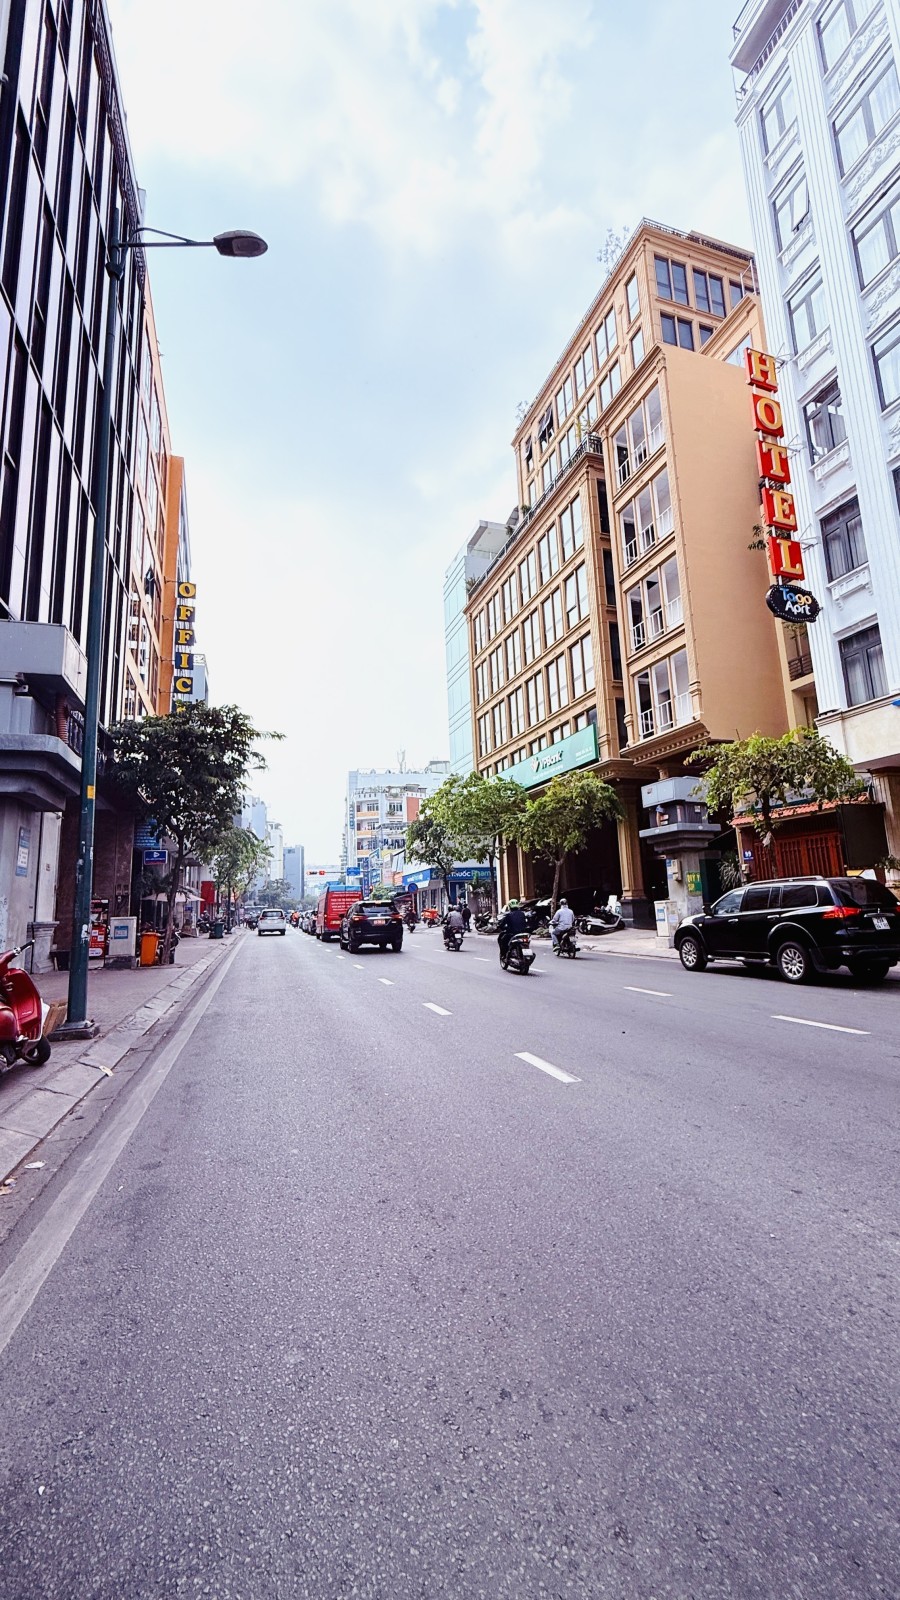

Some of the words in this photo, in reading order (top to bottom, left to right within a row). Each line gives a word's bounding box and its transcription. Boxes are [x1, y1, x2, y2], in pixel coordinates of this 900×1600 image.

[748, 348, 803, 575] HOTEL
[785, 601, 811, 616] Aprt
[540, 750, 563, 769] VPBank
